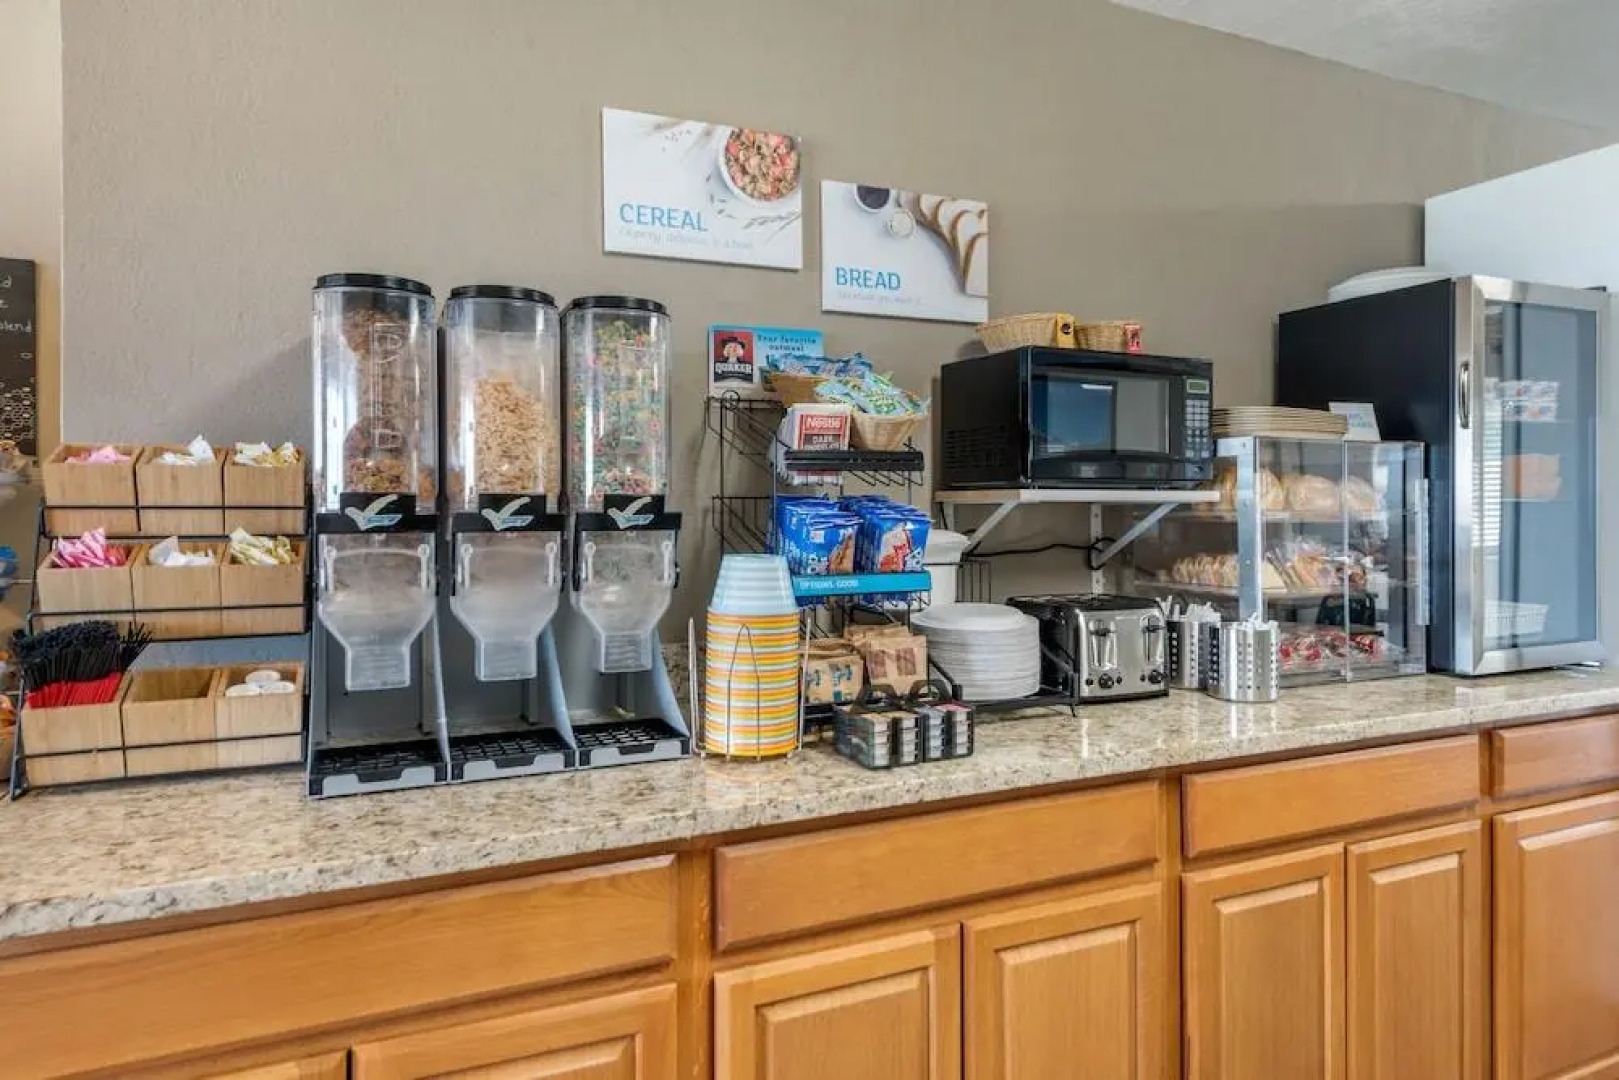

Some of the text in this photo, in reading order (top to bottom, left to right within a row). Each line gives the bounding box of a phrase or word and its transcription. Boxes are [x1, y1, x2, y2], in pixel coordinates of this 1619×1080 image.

[619, 203, 708, 232] CEREAL
[836, 266, 901, 291] BREAD
[758, 334, 817, 344] Your favorite
[768, 344, 804, 352] oatmeal
[715, 361, 753, 375] QUAKER
